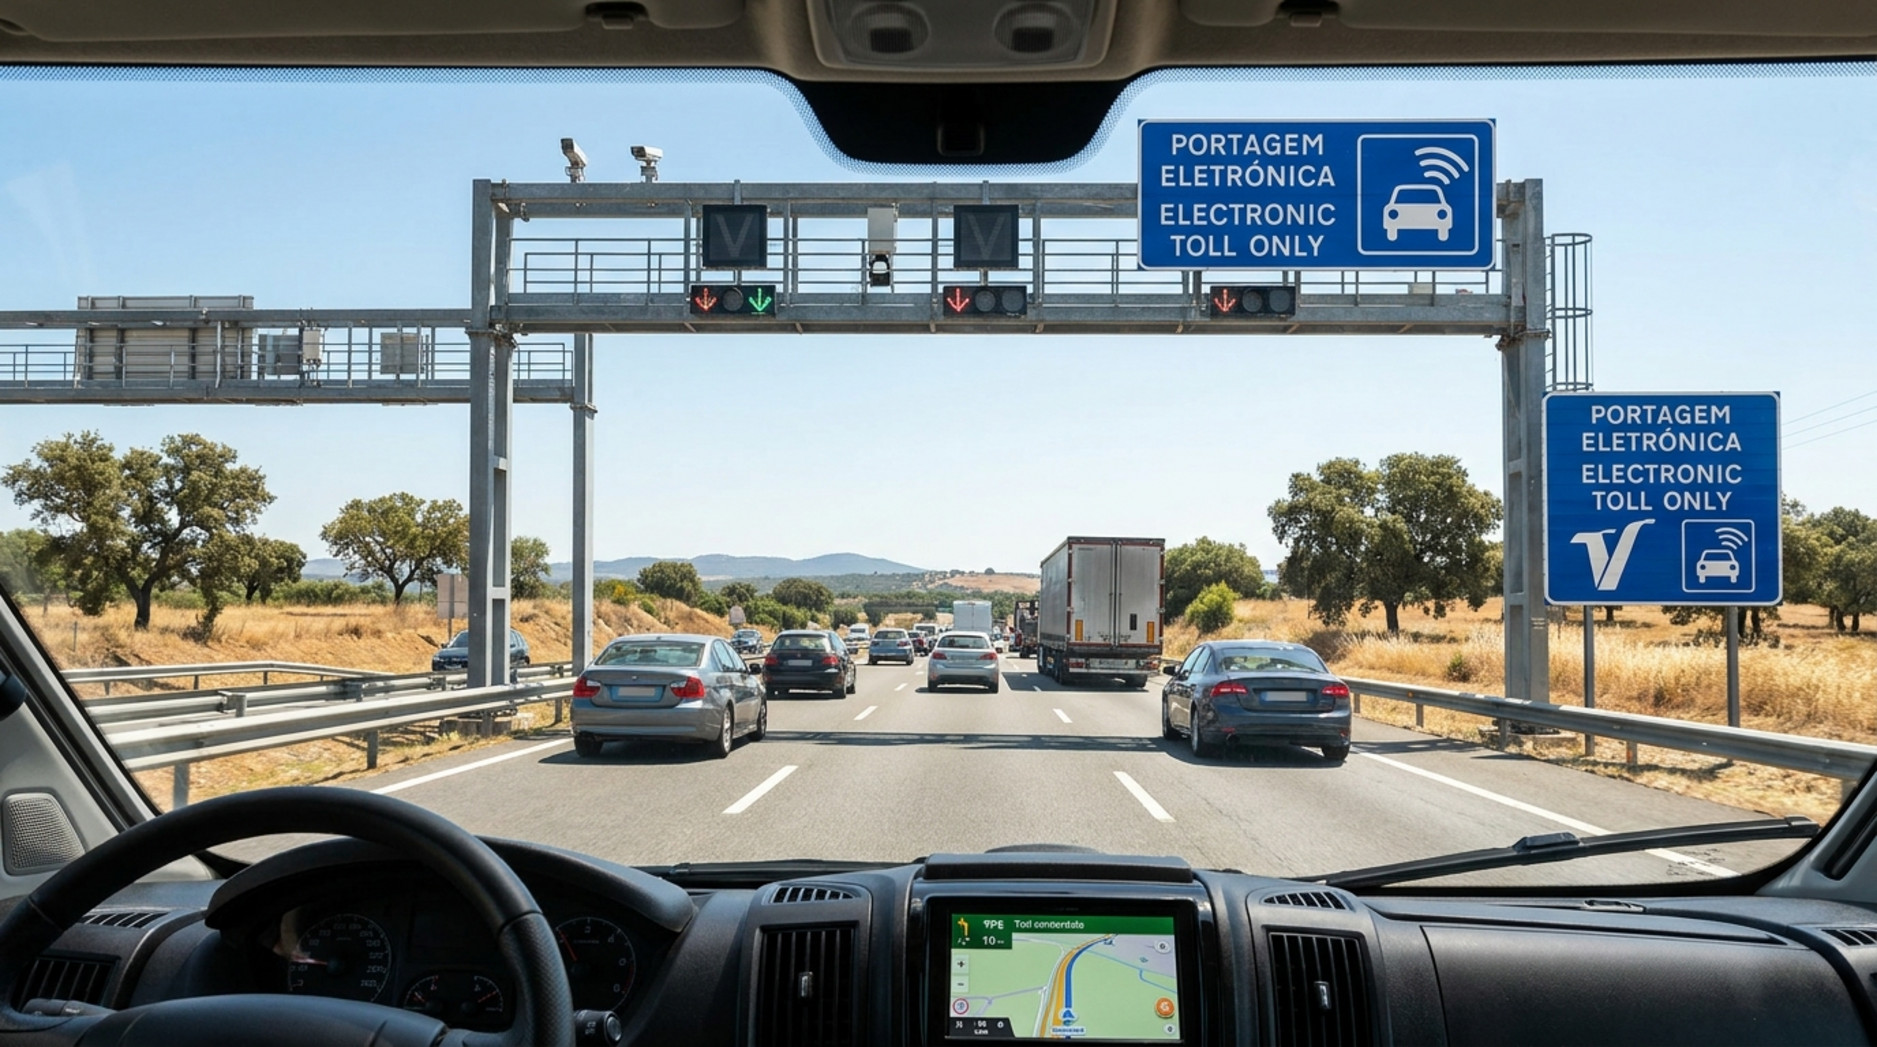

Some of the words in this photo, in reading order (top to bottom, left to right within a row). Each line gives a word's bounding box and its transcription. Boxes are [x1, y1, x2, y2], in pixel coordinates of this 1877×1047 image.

[1172, 134, 1323, 155] PORTAGEM
[1161, 160, 1335, 187] ELETRÓNICA
[1160, 203, 1336, 226] ELECTRONIC
[1170, 235, 1236, 257] TOLL
[1249, 235, 1324, 257] ONLY
[1591, 405, 1730, 425] PORTAGEM
[1582, 428, 1742, 452] ELETRÓNICA
[1582, 464, 1742, 484] ELECTRONIC
[1592, 491, 1653, 511] TOLL
[1663, 491, 1732, 511] ONLY
